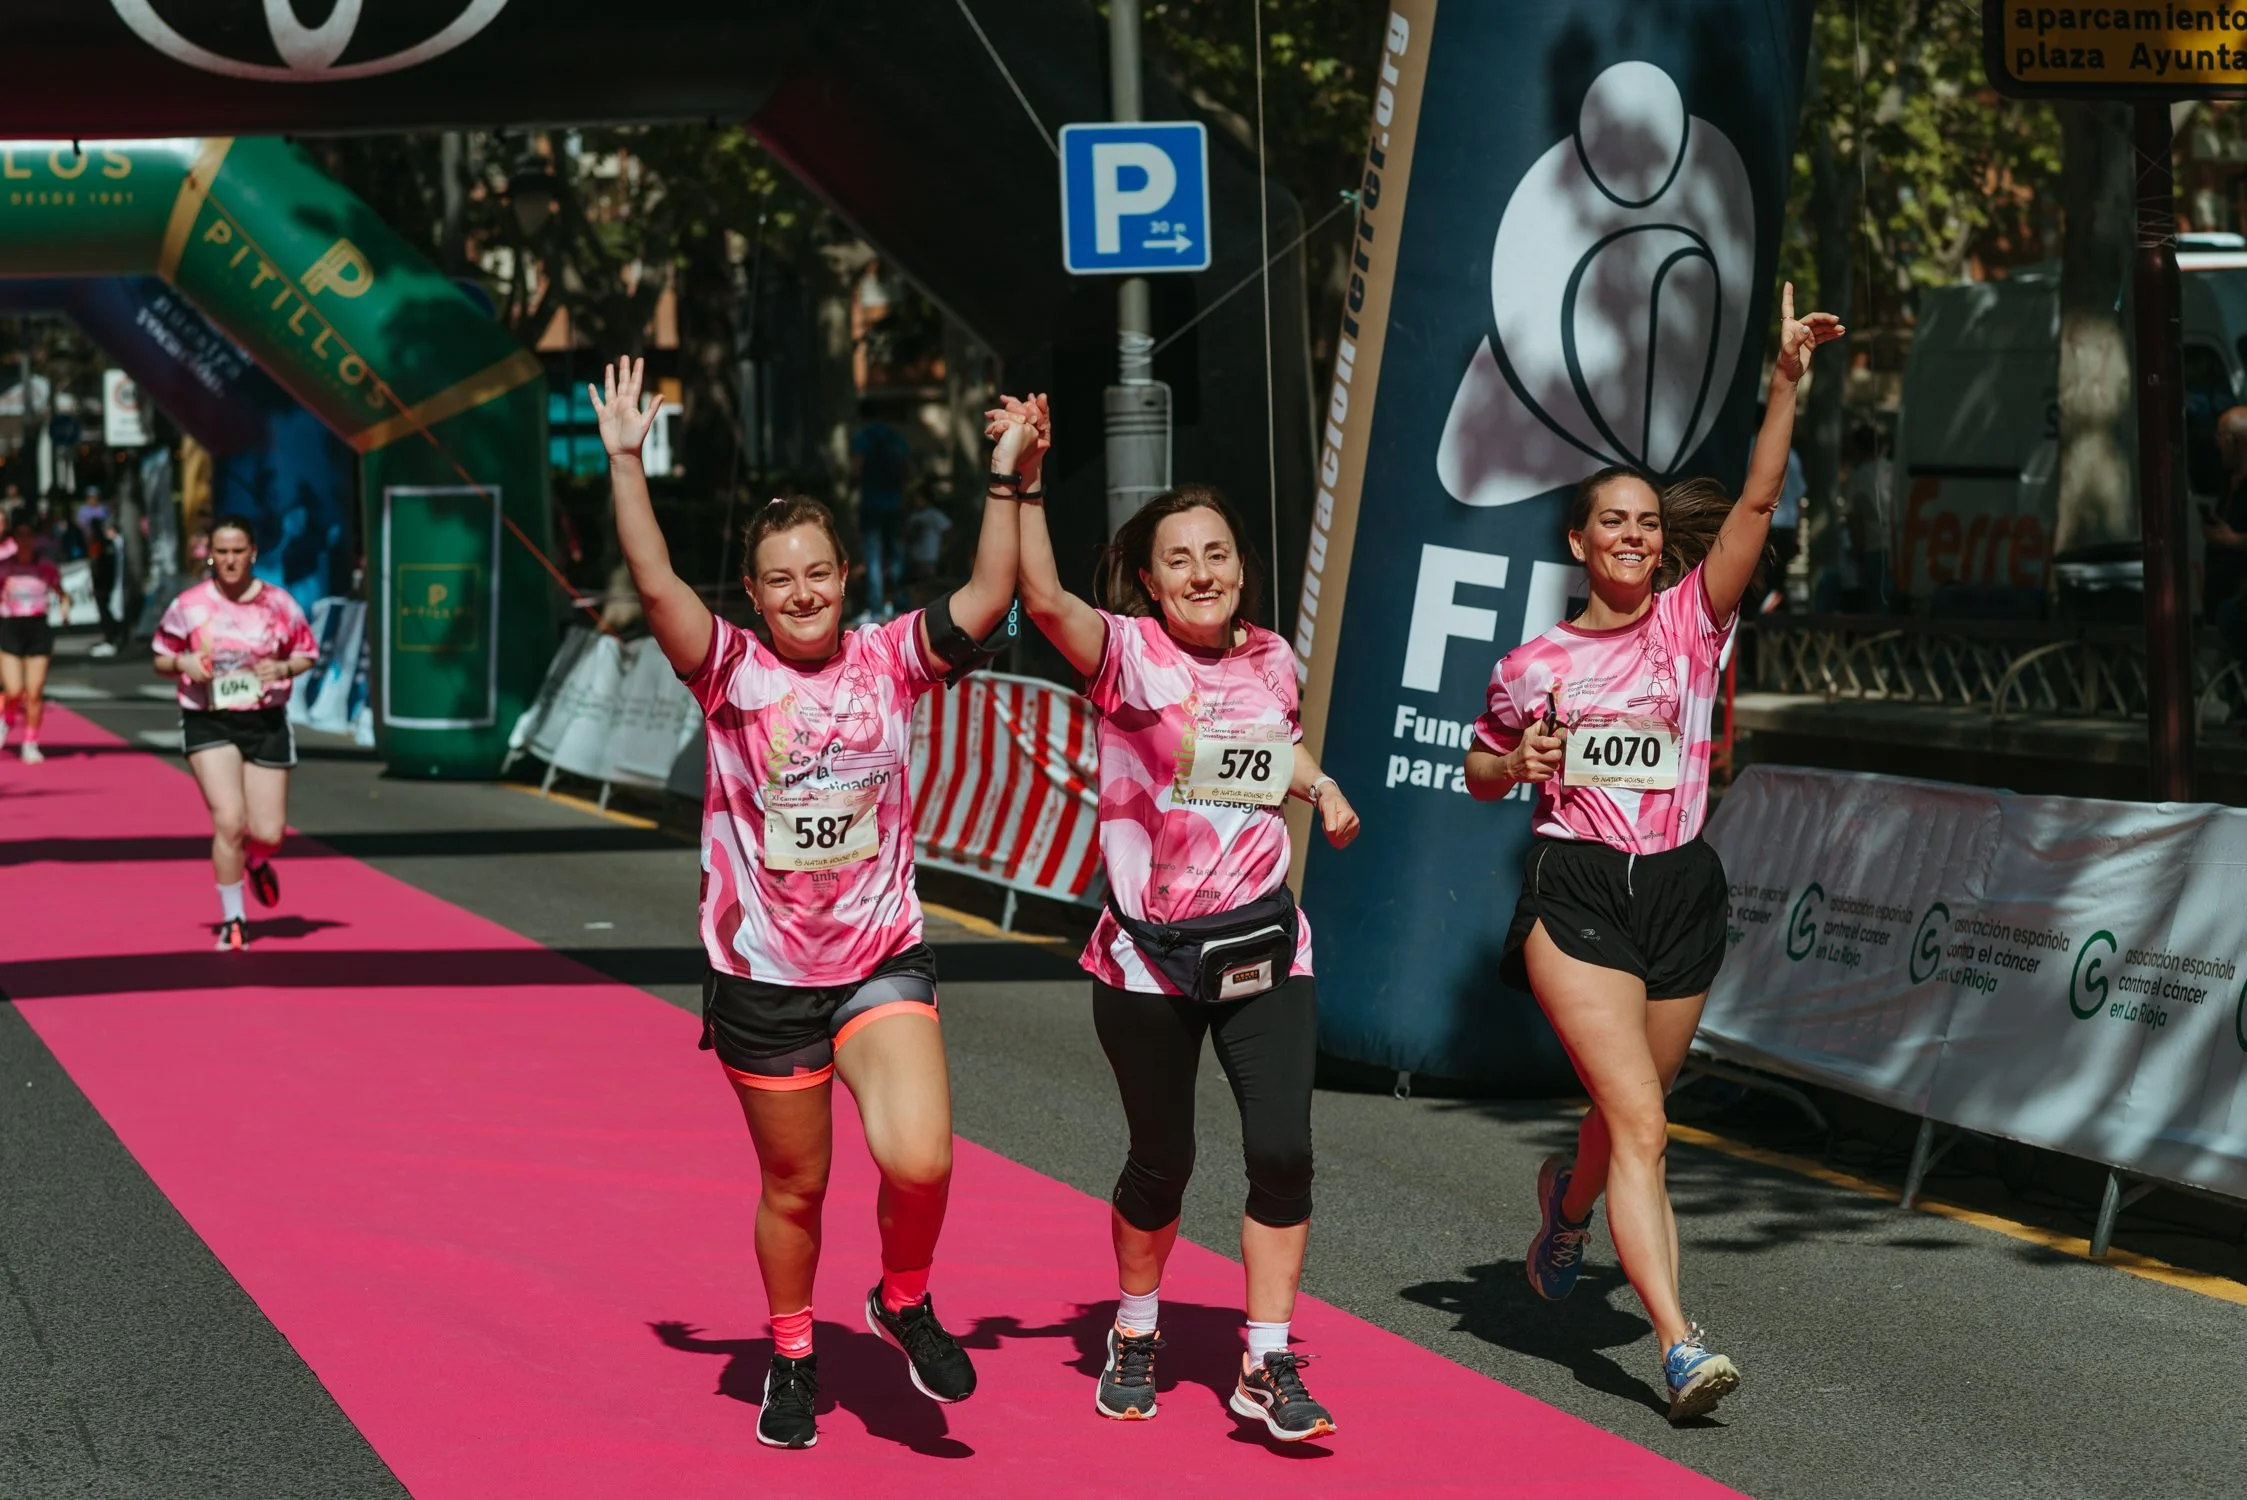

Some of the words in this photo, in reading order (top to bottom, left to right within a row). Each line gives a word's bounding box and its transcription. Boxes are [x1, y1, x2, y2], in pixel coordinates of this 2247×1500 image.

[2015, 3, 2247, 36] aparcamiento
[2016, 42, 2105, 75] plaza
[1093, 142, 1177, 254] P
[1150, 220, 1169, 234] 30
[203, 219, 386, 409] PITILLOS
[1217, 748, 1272, 782] 578
[1583, 735, 1661, 768] 4070
[817, 765, 830, 780] la
[795, 813, 854, 849] 587
[2013, 928, 2070, 953] española
[1978, 944, 1991, 964] el
[1994, 948, 2042, 975] cáncer
[2125, 947, 2180, 972] asociación
[2181, 956, 2236, 981] española
[1961, 966, 1999, 996] Rioja
[2118, 973, 2150, 995] contra
[2150, 976, 2162, 998] el
[2163, 978, 2208, 1005] cáncer
[2109, 1001, 2124, 1018] en
[2124, 1000, 2138, 1022] La
[2137, 1002, 2168, 1031] Rioja
